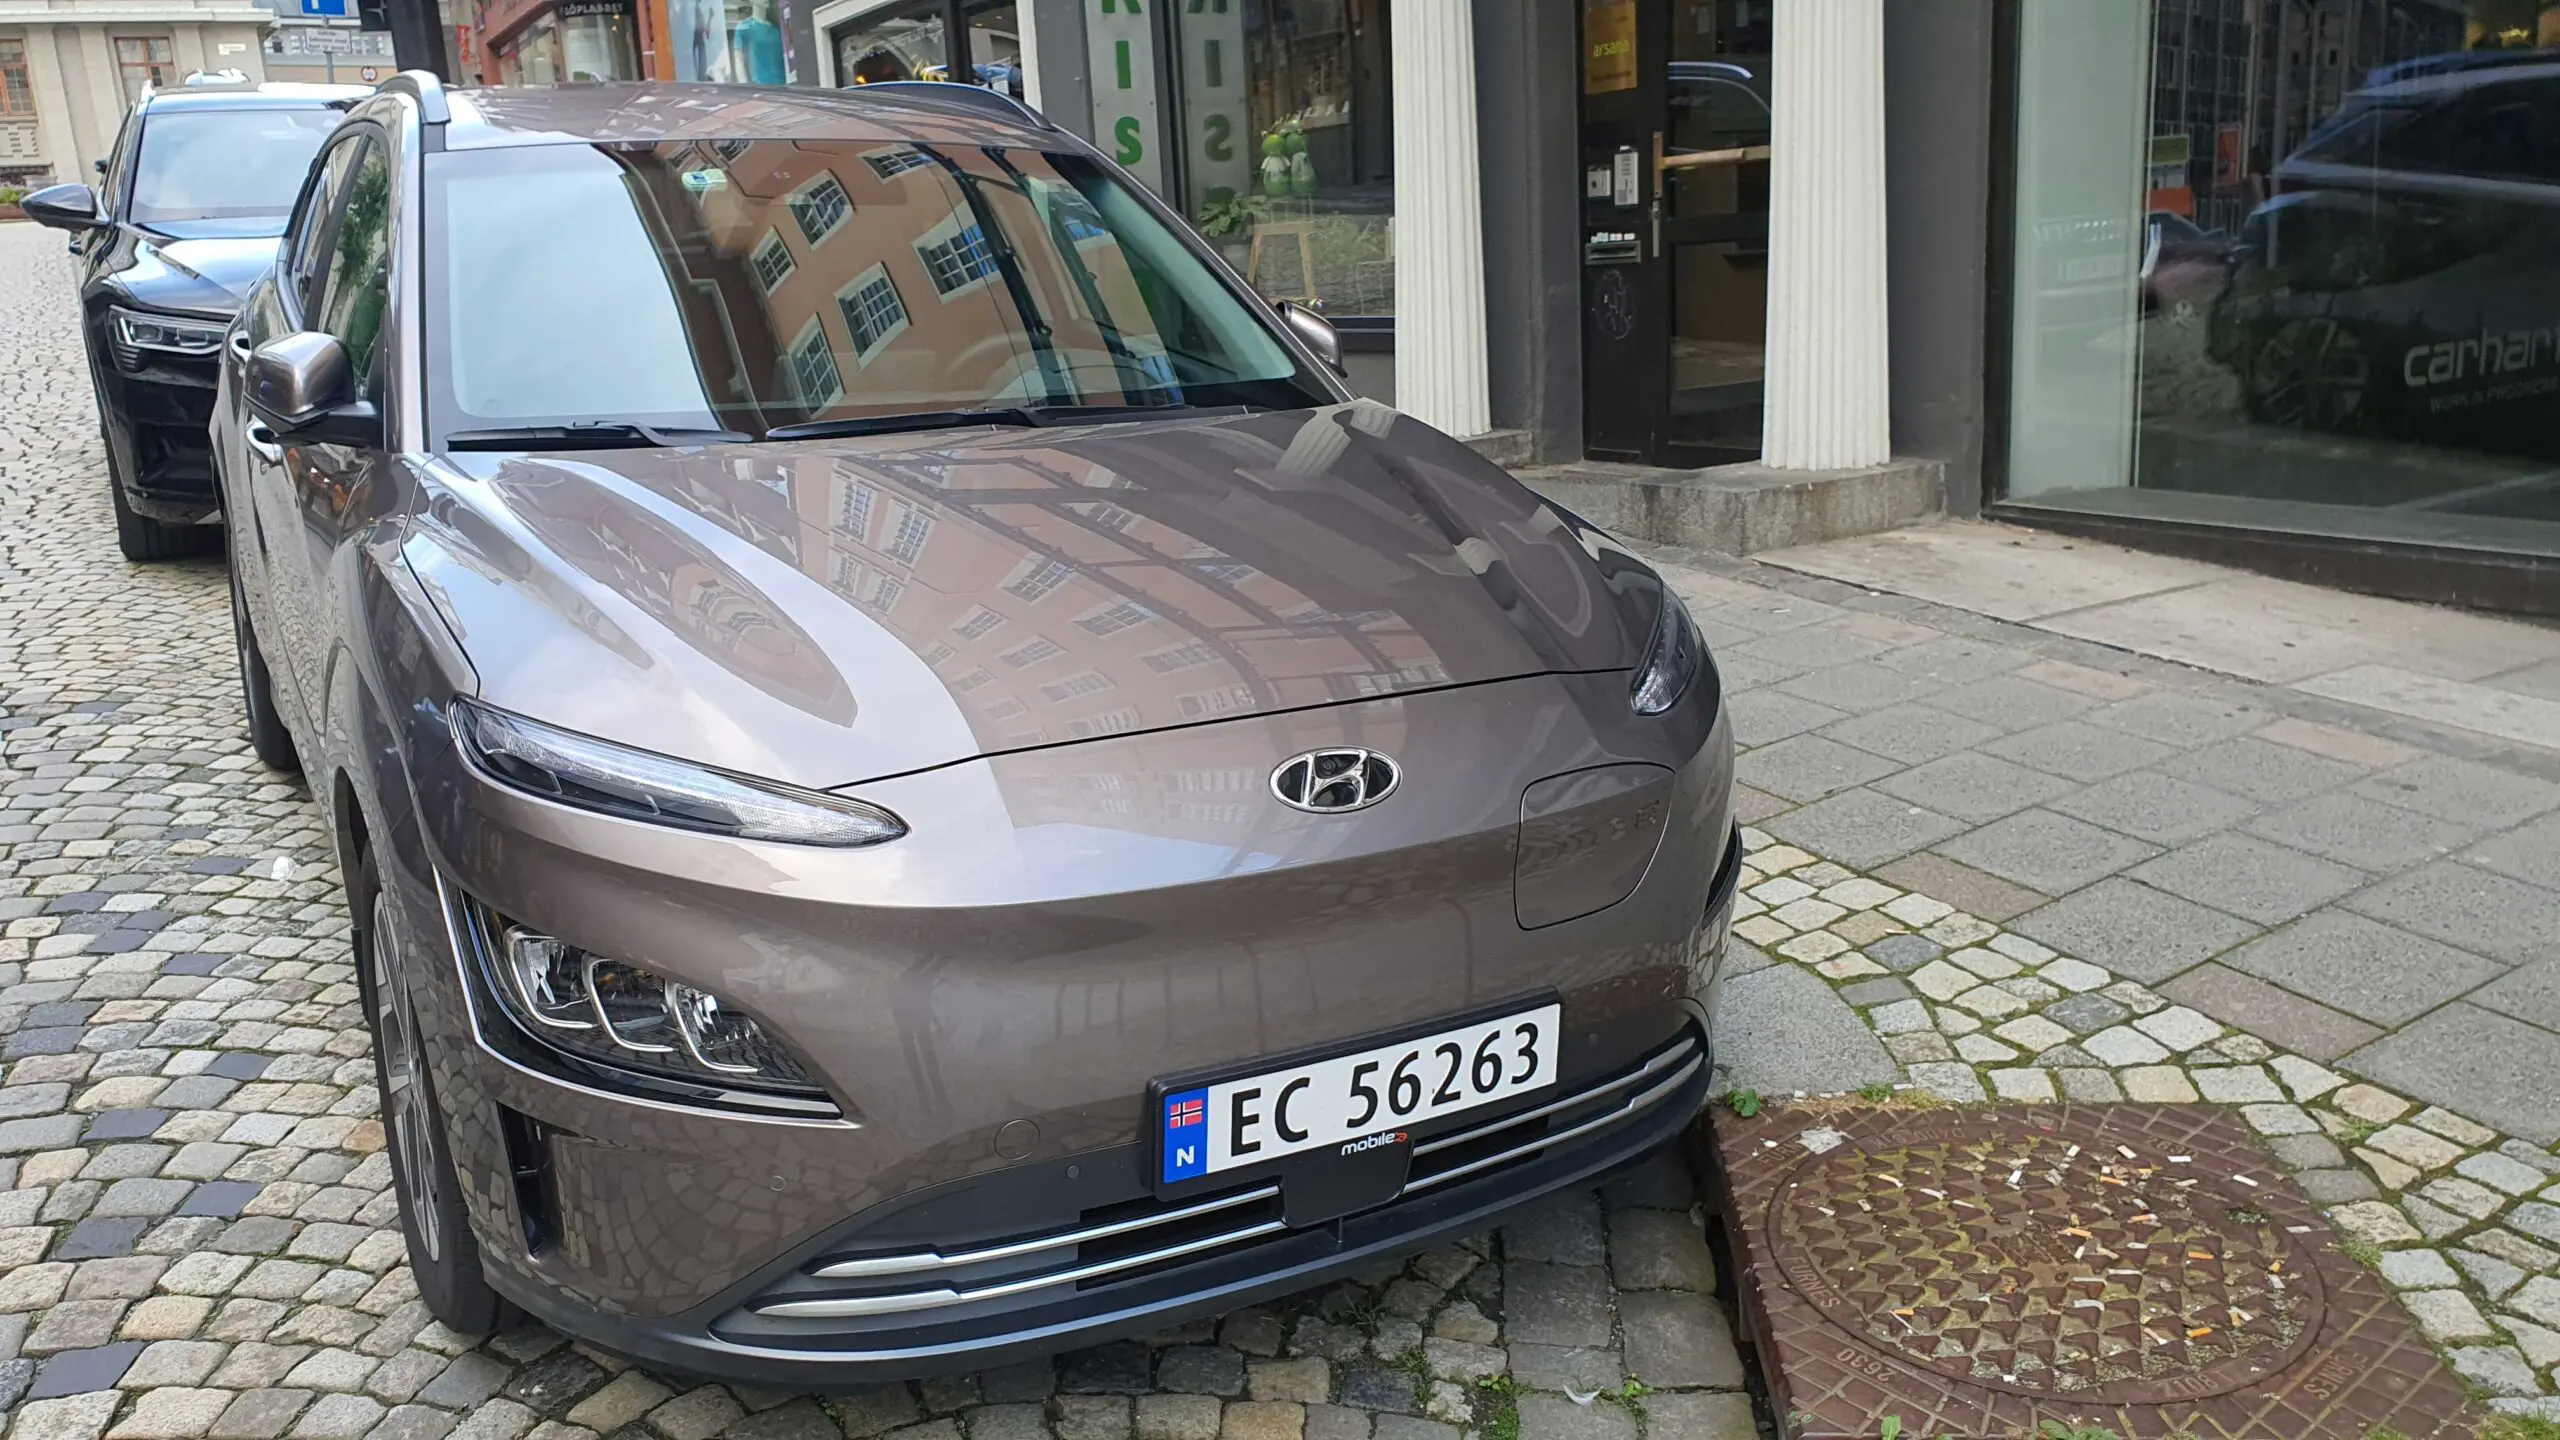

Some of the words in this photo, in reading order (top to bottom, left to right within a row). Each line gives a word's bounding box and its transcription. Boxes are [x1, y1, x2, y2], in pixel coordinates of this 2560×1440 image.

[1100, 0, 1144, 165] IS
[1230, 1077, 1311, 1157] EC
[1346, 1022, 1540, 1129] 56263
[1176, 1145, 1196, 1167] N
[1836, 1348, 1897, 1382] 2630
